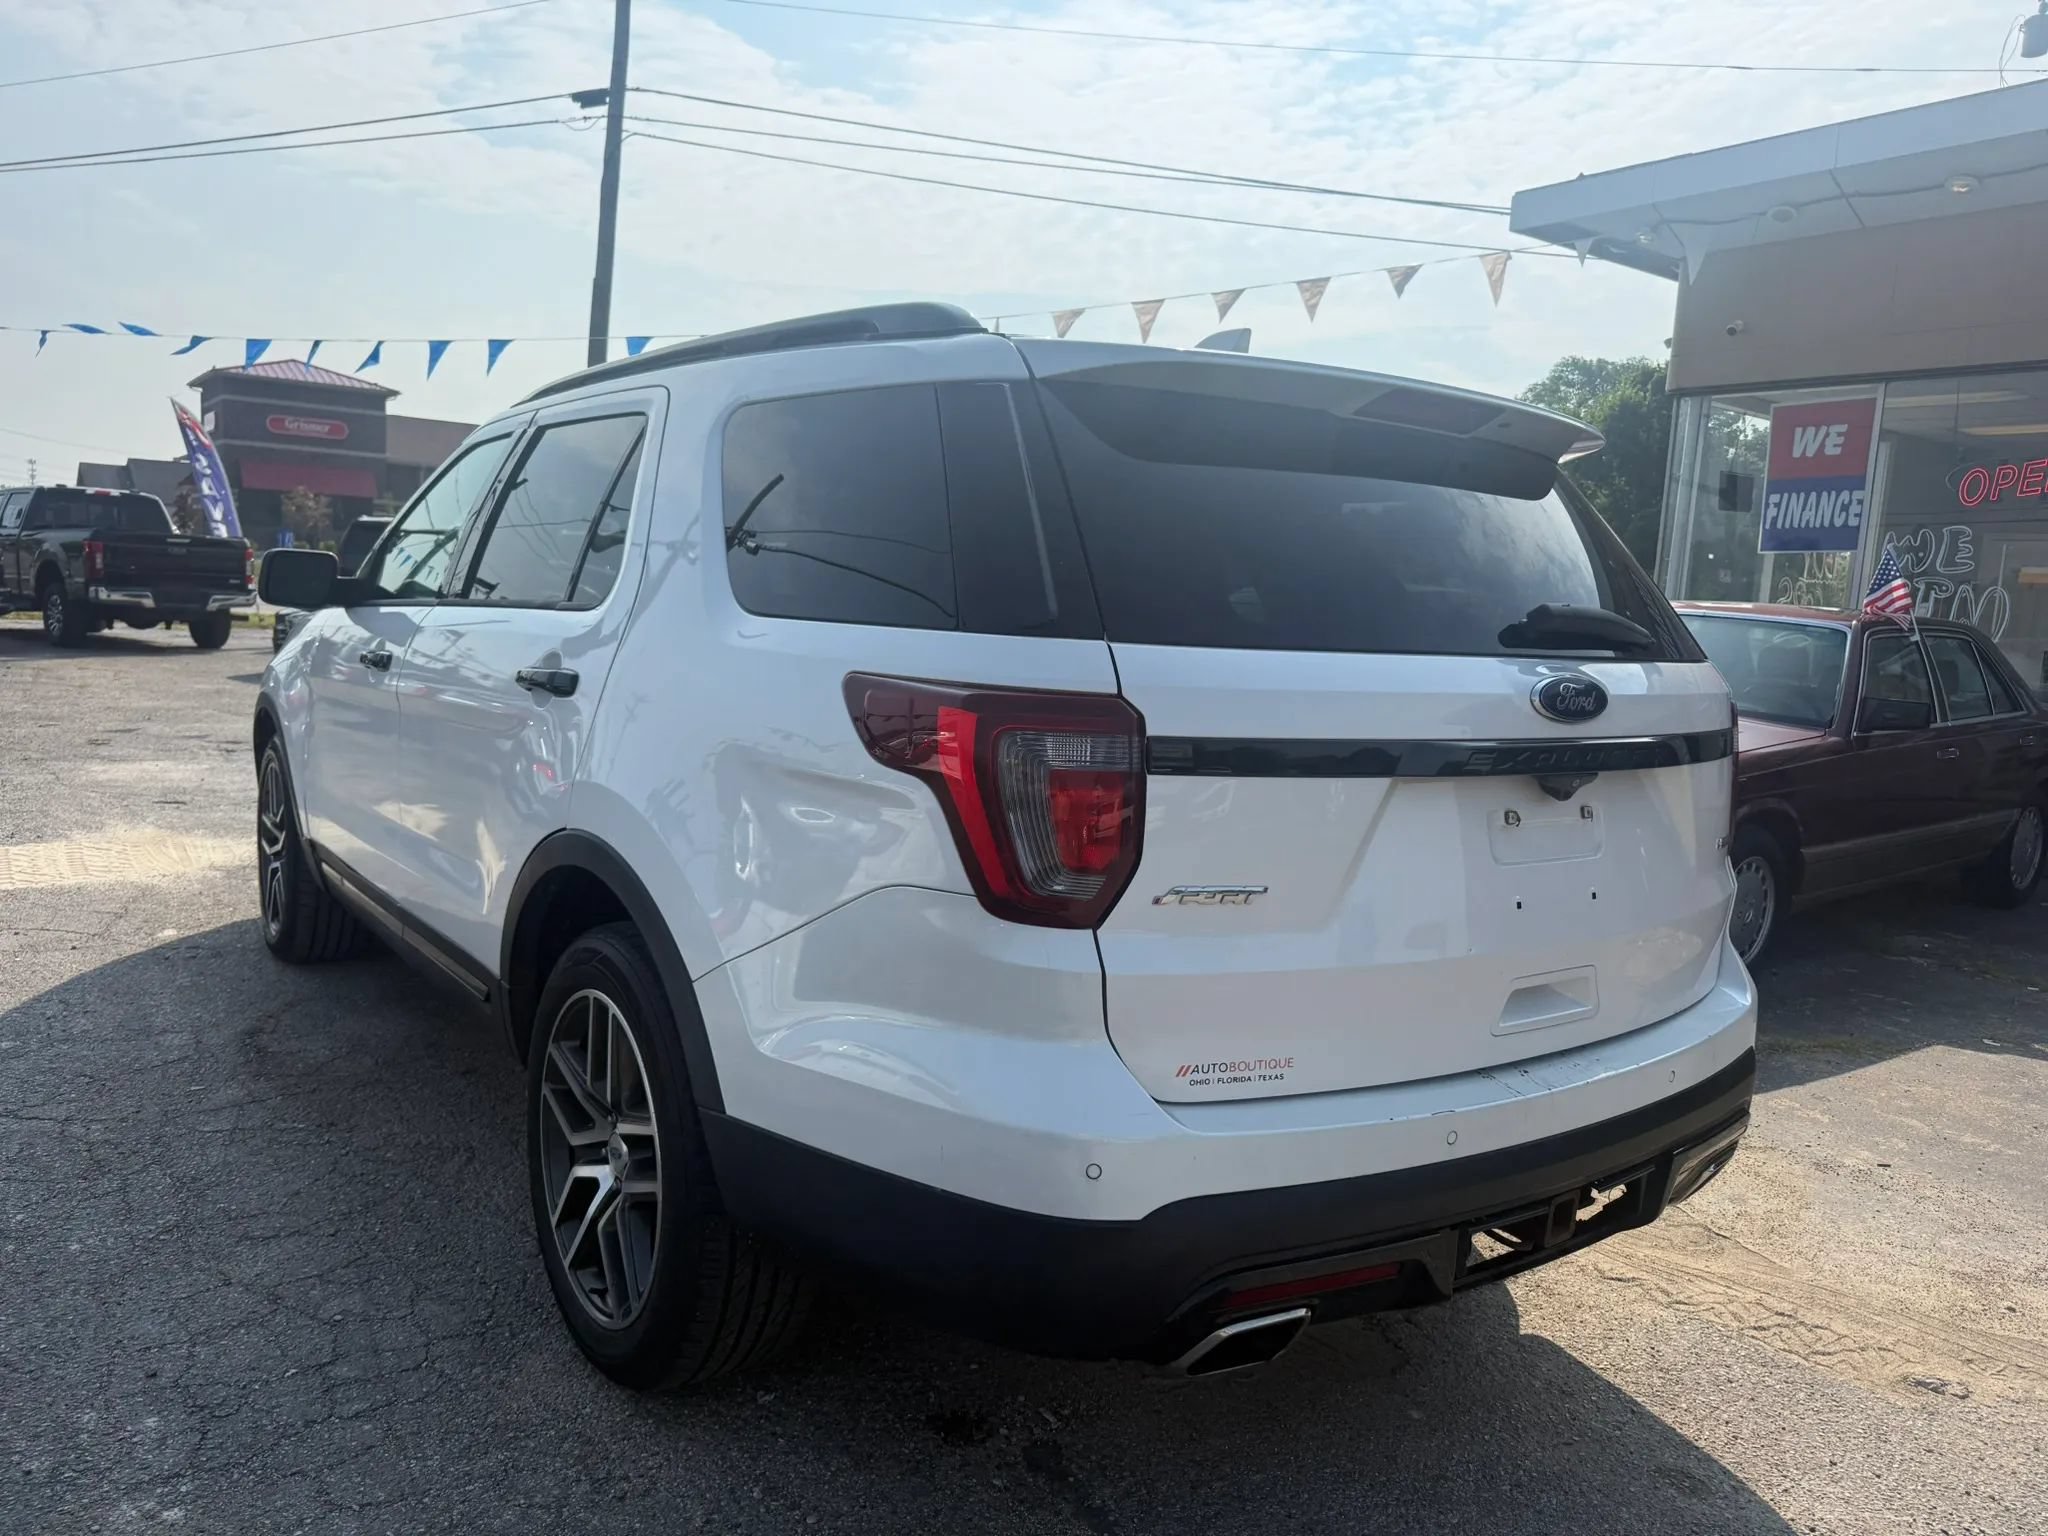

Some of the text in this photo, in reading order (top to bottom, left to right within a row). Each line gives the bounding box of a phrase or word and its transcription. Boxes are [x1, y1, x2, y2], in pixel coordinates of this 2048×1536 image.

[1792, 424, 1848, 458] WE
[1959, 457, 2048, 506] OPE
[1765, 489, 1866, 530] FINANCE
[1883, 525, 1975, 574] WE
[1556, 682, 1597, 712] Ford
[1463, 747, 1668, 771] EXPLO
[1189, 1073, 1284, 1087] OHIO FLORIDA TEXAS
